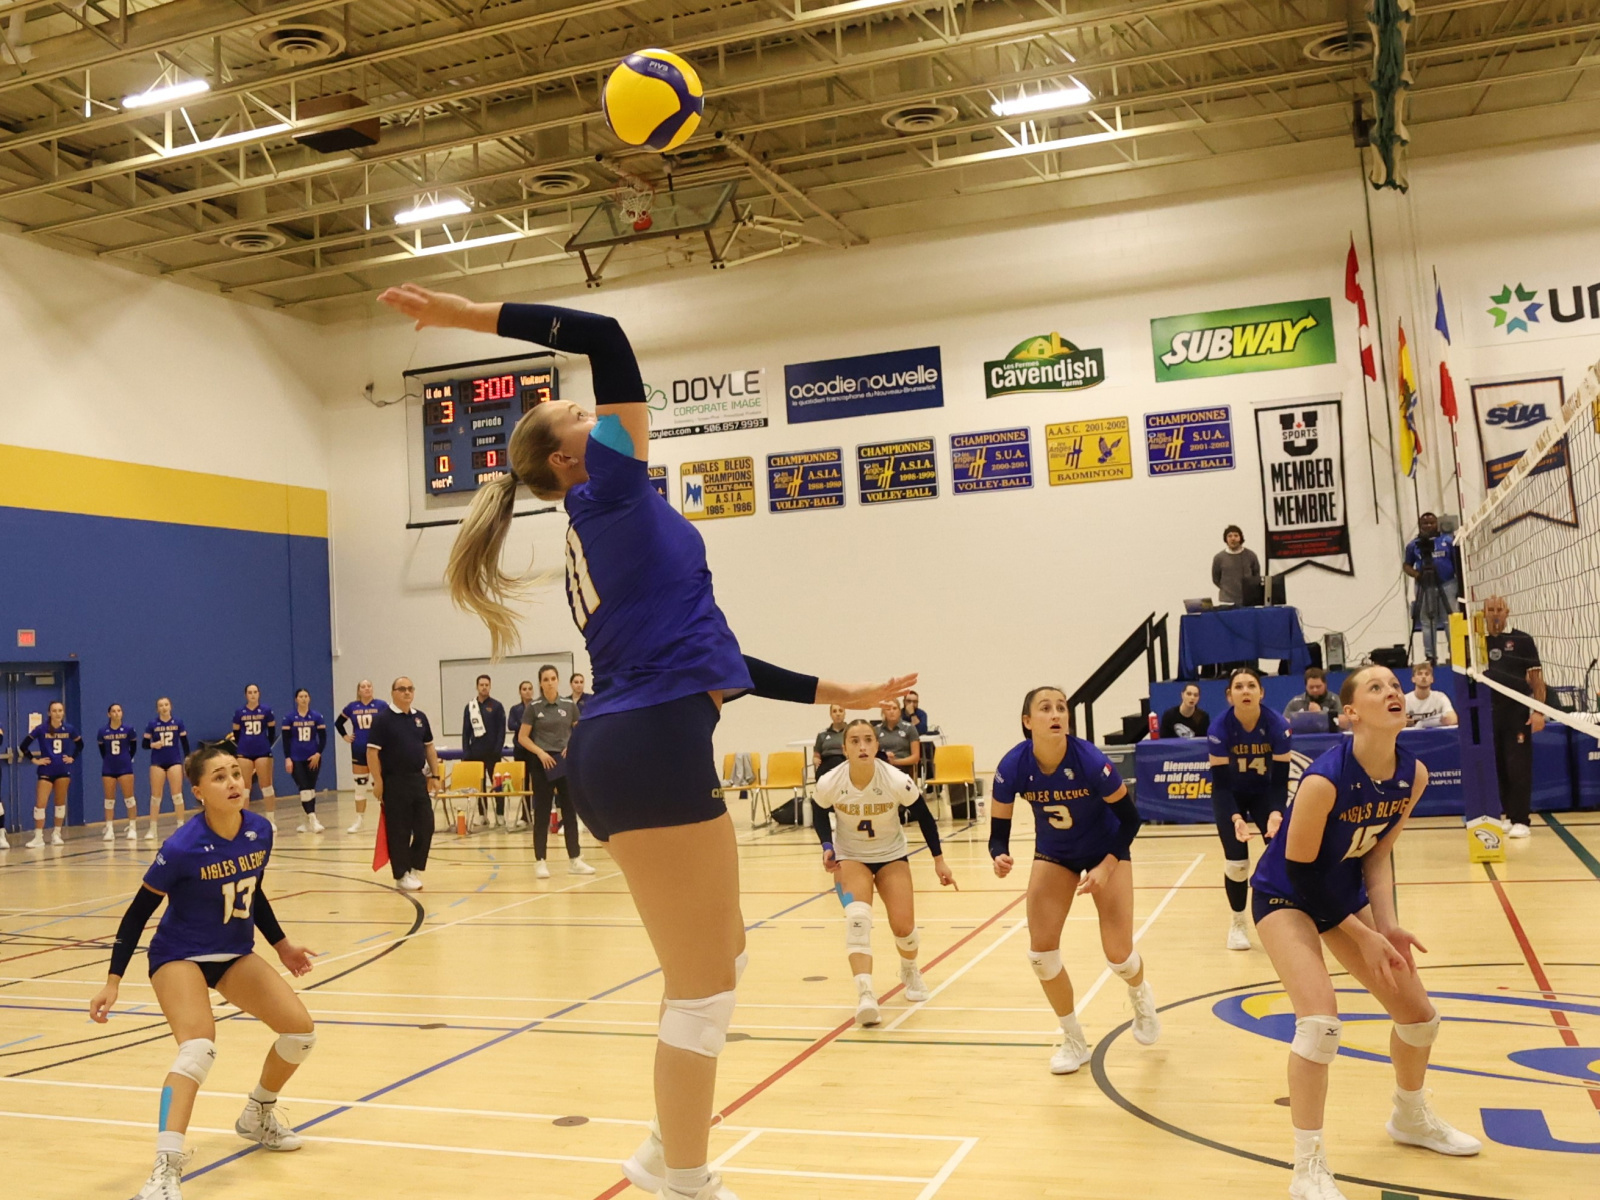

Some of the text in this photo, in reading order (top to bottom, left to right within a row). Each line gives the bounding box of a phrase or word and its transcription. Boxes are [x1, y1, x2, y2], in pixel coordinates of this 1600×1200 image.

[649, 60, 669, 72] FIVB
[1160, 313, 1319, 368] SUBWAY
[991, 356, 1098, 389] Cavendish
[473, 375, 514, 402] 3:00
[672, 370, 761, 403] DOYLE
[1061, 379, 1084, 388] Farms
[826, 392, 865, 403] francophone
[874, 384, 936, 397] Nouveau-Brunswick
[440, 401, 454, 424] 3
[673, 397, 762, 417] CORPORATE IMAGE
[1484, 402, 1548, 427] SUA
[1085, 420, 1127, 432] 2001-2002
[1148, 409, 1227, 427] CHAMPIONNES
[953, 430, 1026, 447] CHAMPIONNES
[1192, 429, 1225, 442] S.U.A.
[1281, 428, 1318, 441] SPORTS
[860, 440, 931, 458] CHAMPIONNES
[1189, 440, 1230, 451] 2001-2002
[486, 450, 497, 468] 0
[770, 451, 839, 467] CHAMPIONNES
[995, 449, 1026, 461] S.U.A.
[439, 455, 449, 473] 0
[692, 461, 719, 475] AIGLES
[724, 458, 752, 471] BLEUS
[899, 458, 934, 471] A.S.I.A.
[991, 461, 1028, 471] 2000-2001
[1153, 458, 1230, 472] VOLLEY-BALL
[703, 470, 752, 484] CHAMPIONS
[1057, 467, 1124, 482] BADMINTON
[1270, 457, 1335, 493] MEMBER
[957, 476, 1030, 491] VOLLEY-BALL
[866, 487, 932, 502] VOLLEY-BALL
[775, 496, 839, 511] VOLLEY-BALL
[1273, 491, 1337, 527] MEMBRE
[244, 720, 262, 736] 20
[356, 714, 373, 730] 10
[159, 731, 174, 747] 12
[297, 726, 312, 742] 18
[53, 739, 63, 754] 9
[111, 740, 121, 755] 6
[1237, 757, 1267, 775] 14
[1166, 772, 1183, 783] nid
[1182, 771, 1201, 782] des
[1043, 804, 1074, 830] 3
[857, 819, 875, 838] 4
[200, 859, 237, 880] AIGLES
[221, 875, 257, 925] 13
